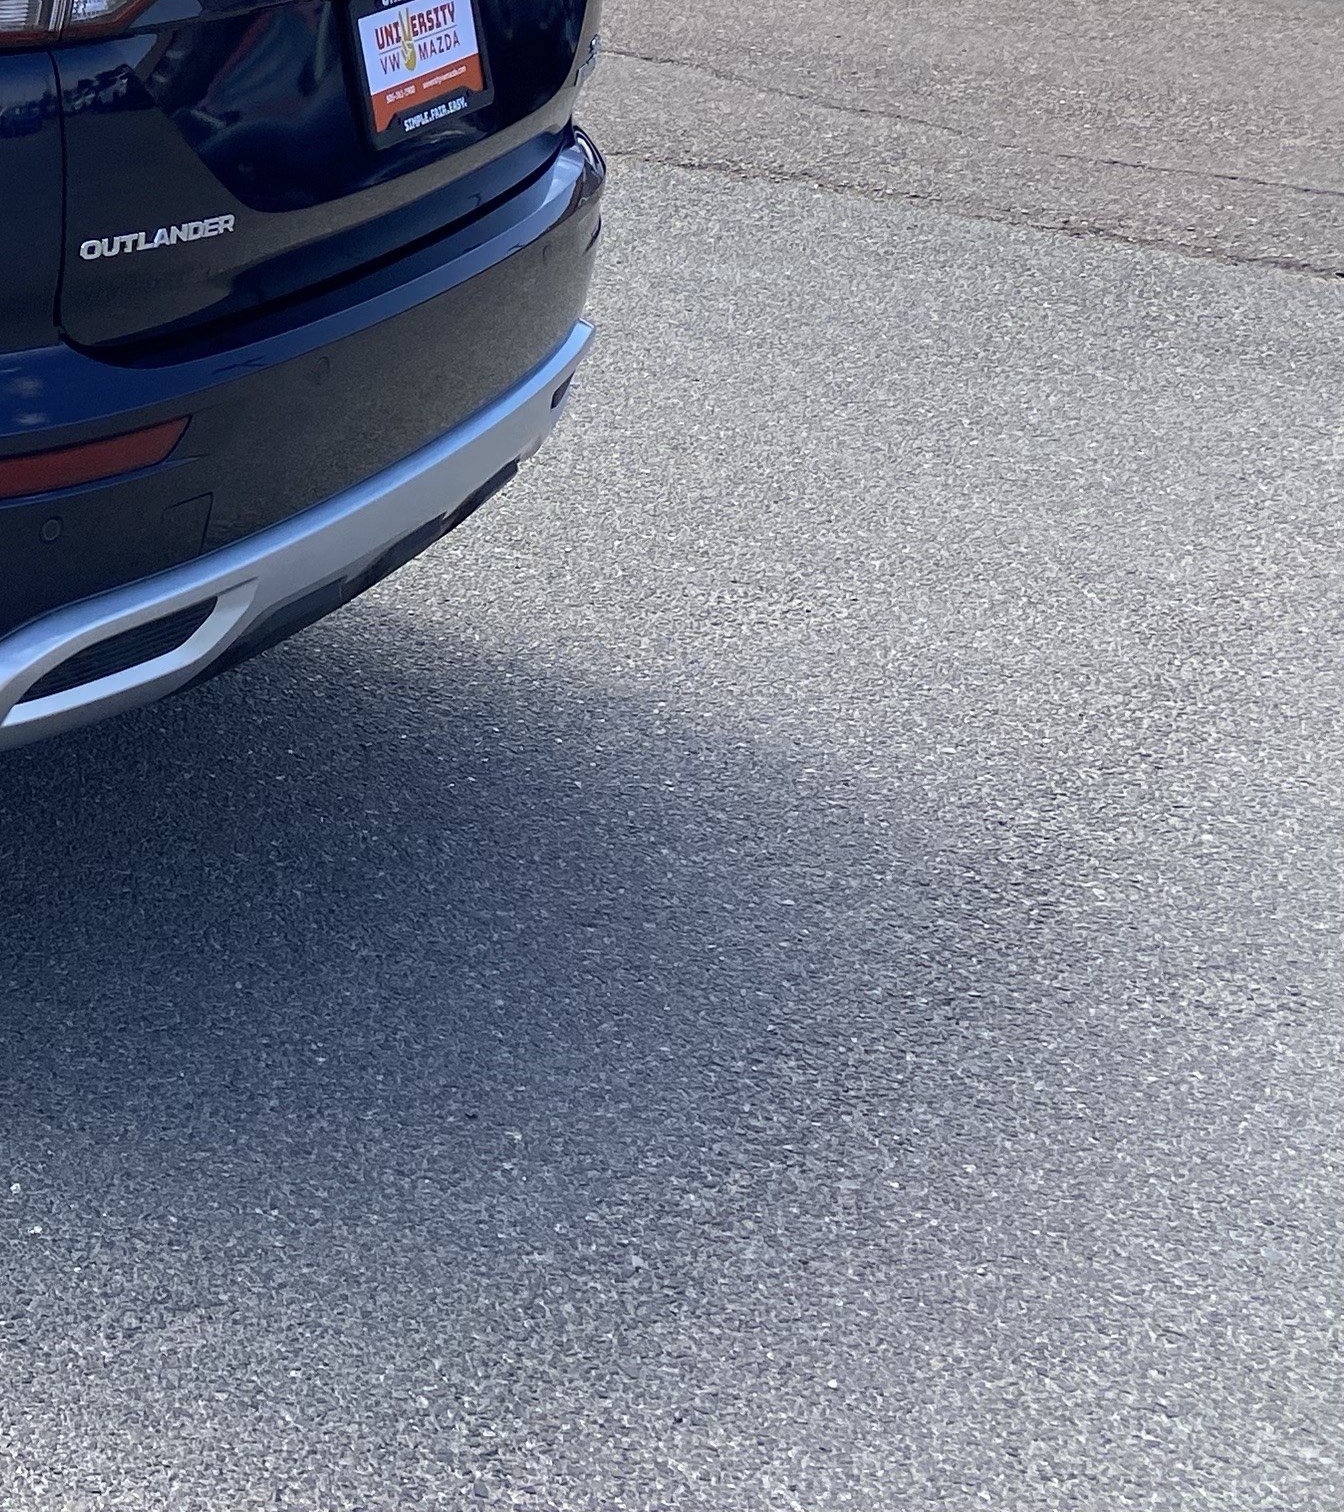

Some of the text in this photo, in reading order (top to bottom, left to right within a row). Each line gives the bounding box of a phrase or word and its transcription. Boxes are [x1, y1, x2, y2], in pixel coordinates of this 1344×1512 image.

[374, 0, 456, 50] UNIVERSITY
[379, 31, 461, 75] VW MAZDA
[79, 213, 236, 261] OUTLANDER
